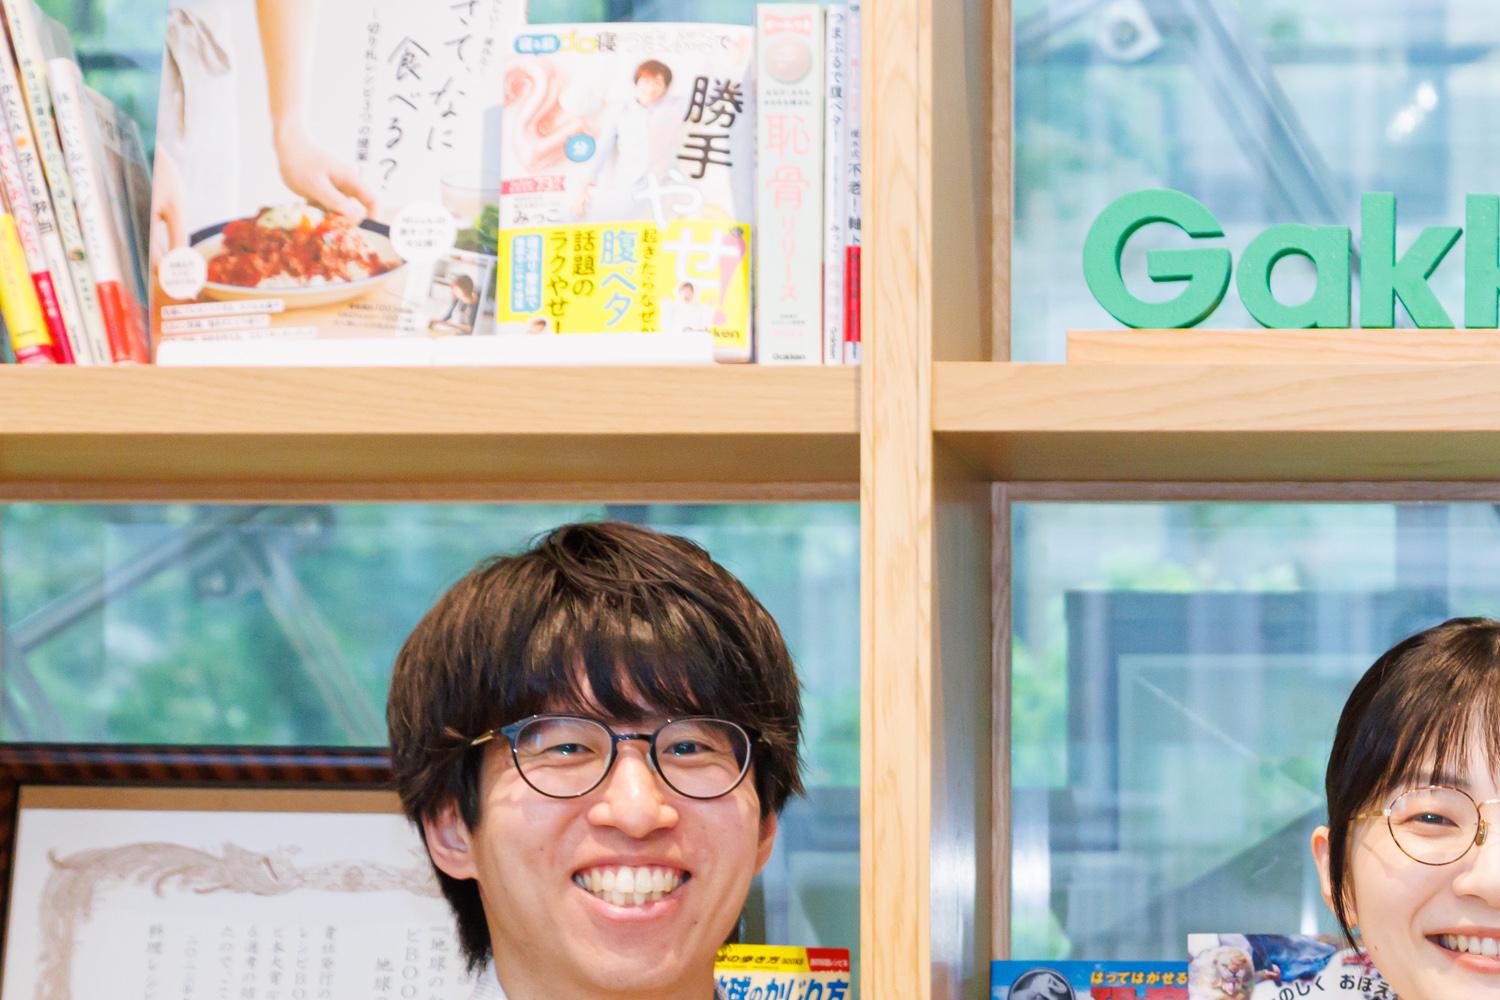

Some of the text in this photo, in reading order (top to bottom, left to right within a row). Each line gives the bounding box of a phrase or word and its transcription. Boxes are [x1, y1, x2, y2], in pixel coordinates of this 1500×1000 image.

[572, 230, 595, 296] 話題の
[600, 229, 638, 327] 腹ペタ
[1089, 971, 1188, 985] はってはがせる
